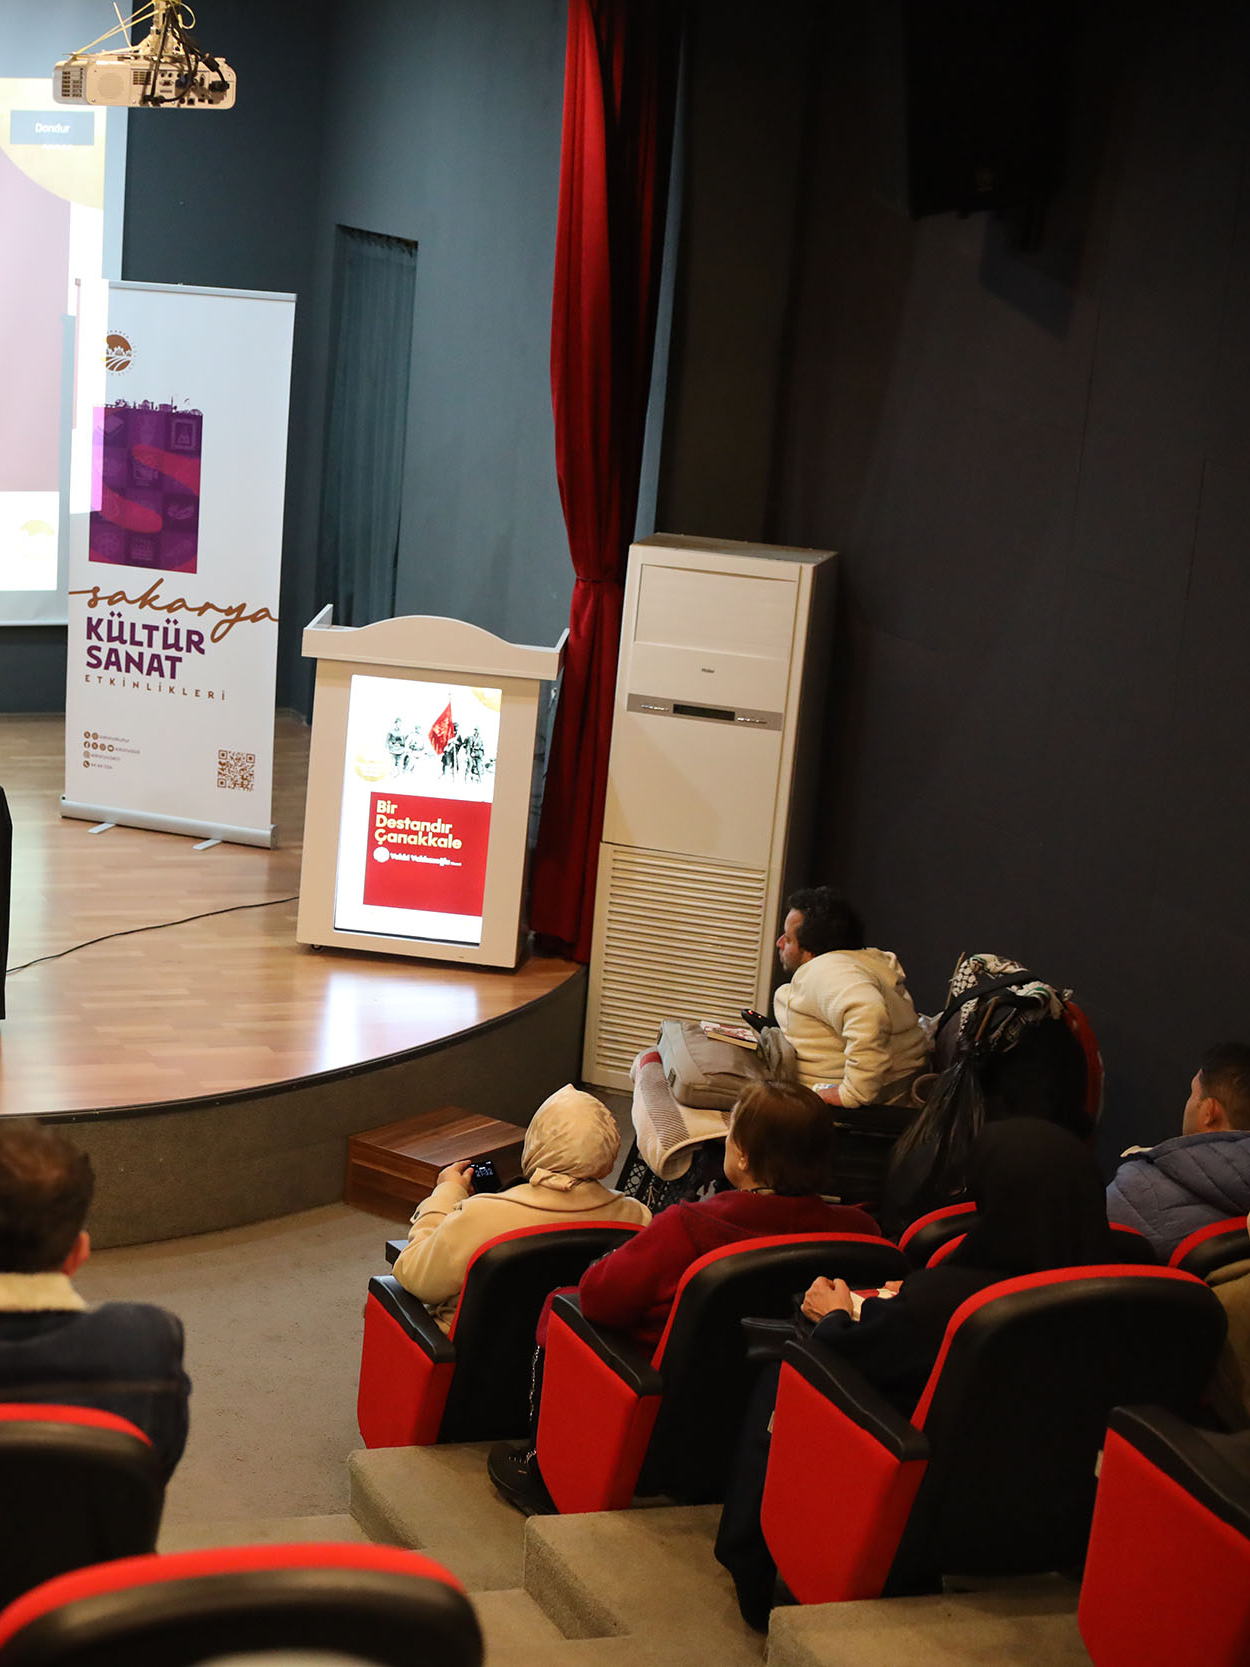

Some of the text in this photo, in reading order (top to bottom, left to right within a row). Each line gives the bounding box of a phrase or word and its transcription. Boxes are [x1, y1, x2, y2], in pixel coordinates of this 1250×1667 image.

[68, 577, 279, 643] sakarya
[86, 611, 205, 655] KÜLTÜR
[86, 645, 182, 680] SANAT
[85, 674, 225, 701] ETKİNLİKLERİ
[376, 800, 398, 814] Bir
[375, 814, 453, 834] Destandır
[374, 829, 462, 849] Çanakkale
